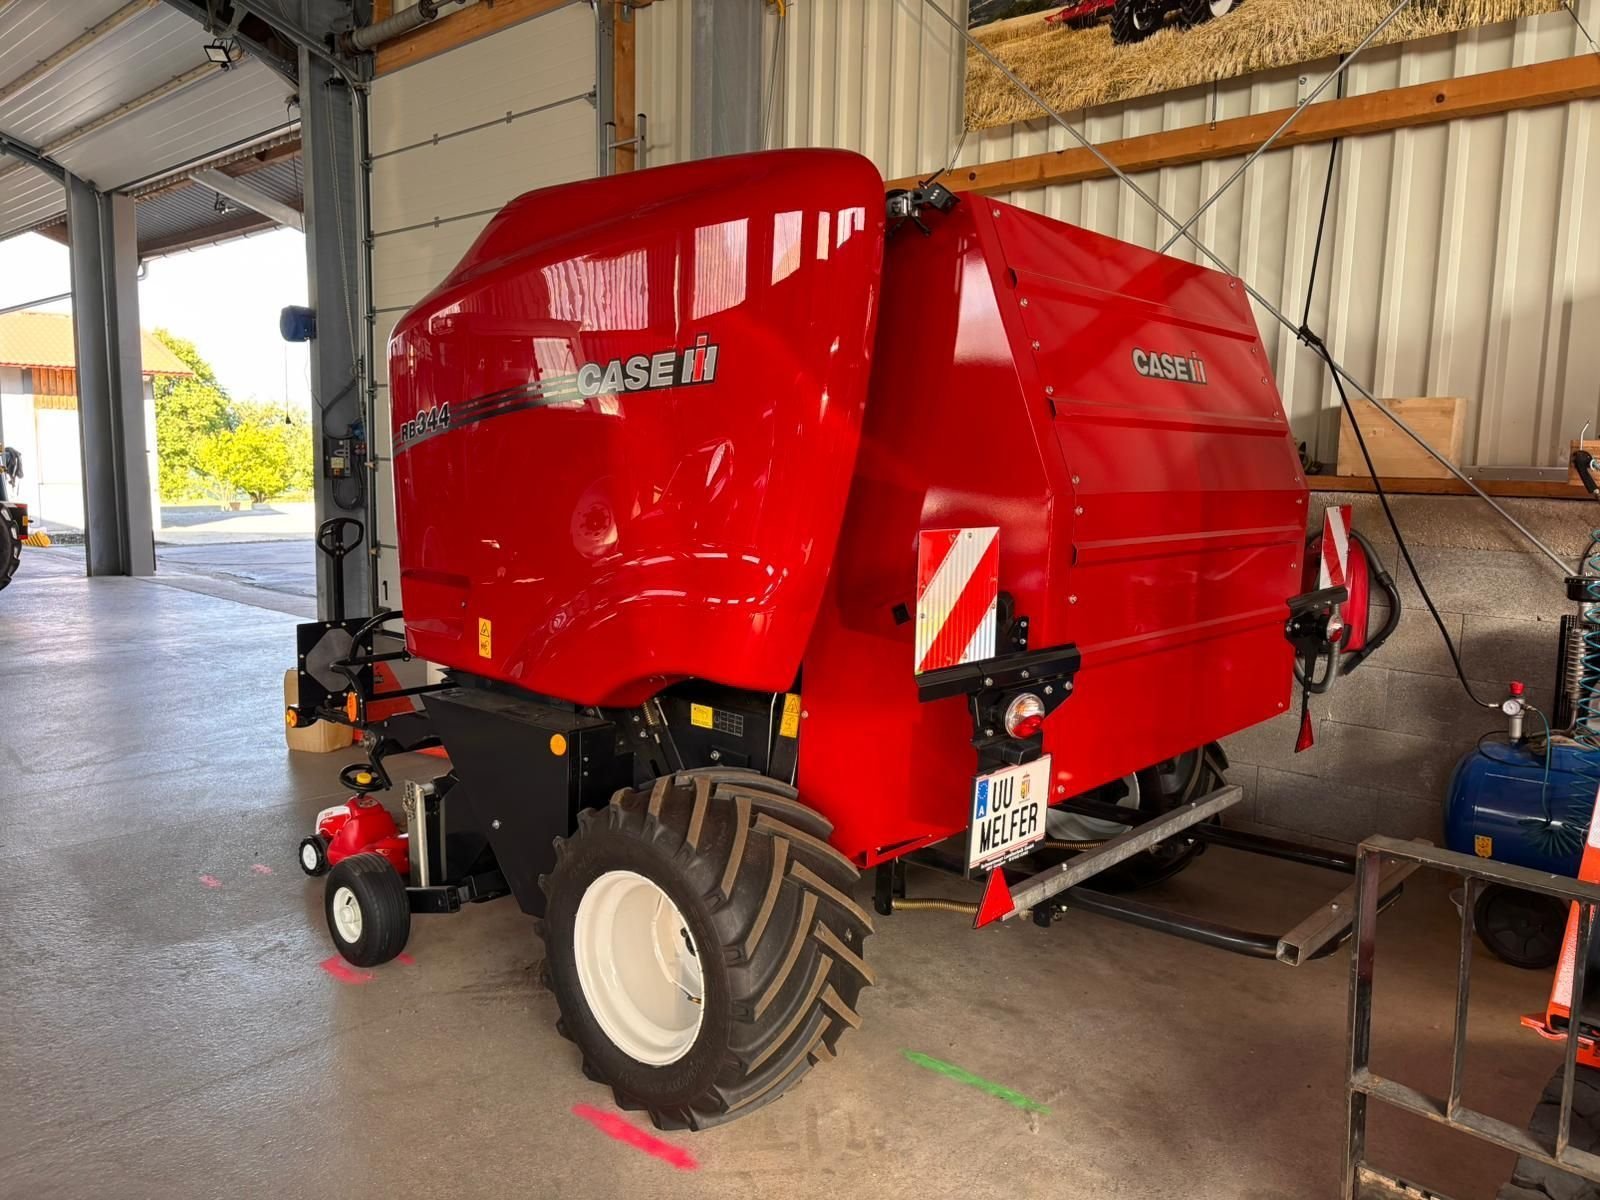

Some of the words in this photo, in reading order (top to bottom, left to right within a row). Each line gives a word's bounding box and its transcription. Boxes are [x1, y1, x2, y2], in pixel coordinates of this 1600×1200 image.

[577, 351, 677, 396] CASE
[1132, 348, 1189, 381] CASE
[382, 580, 388, 601] 1
[978, 806, 985, 817] A
[992, 776, 1014, 813] UU
[980, 802, 1038, 853] MELFER
